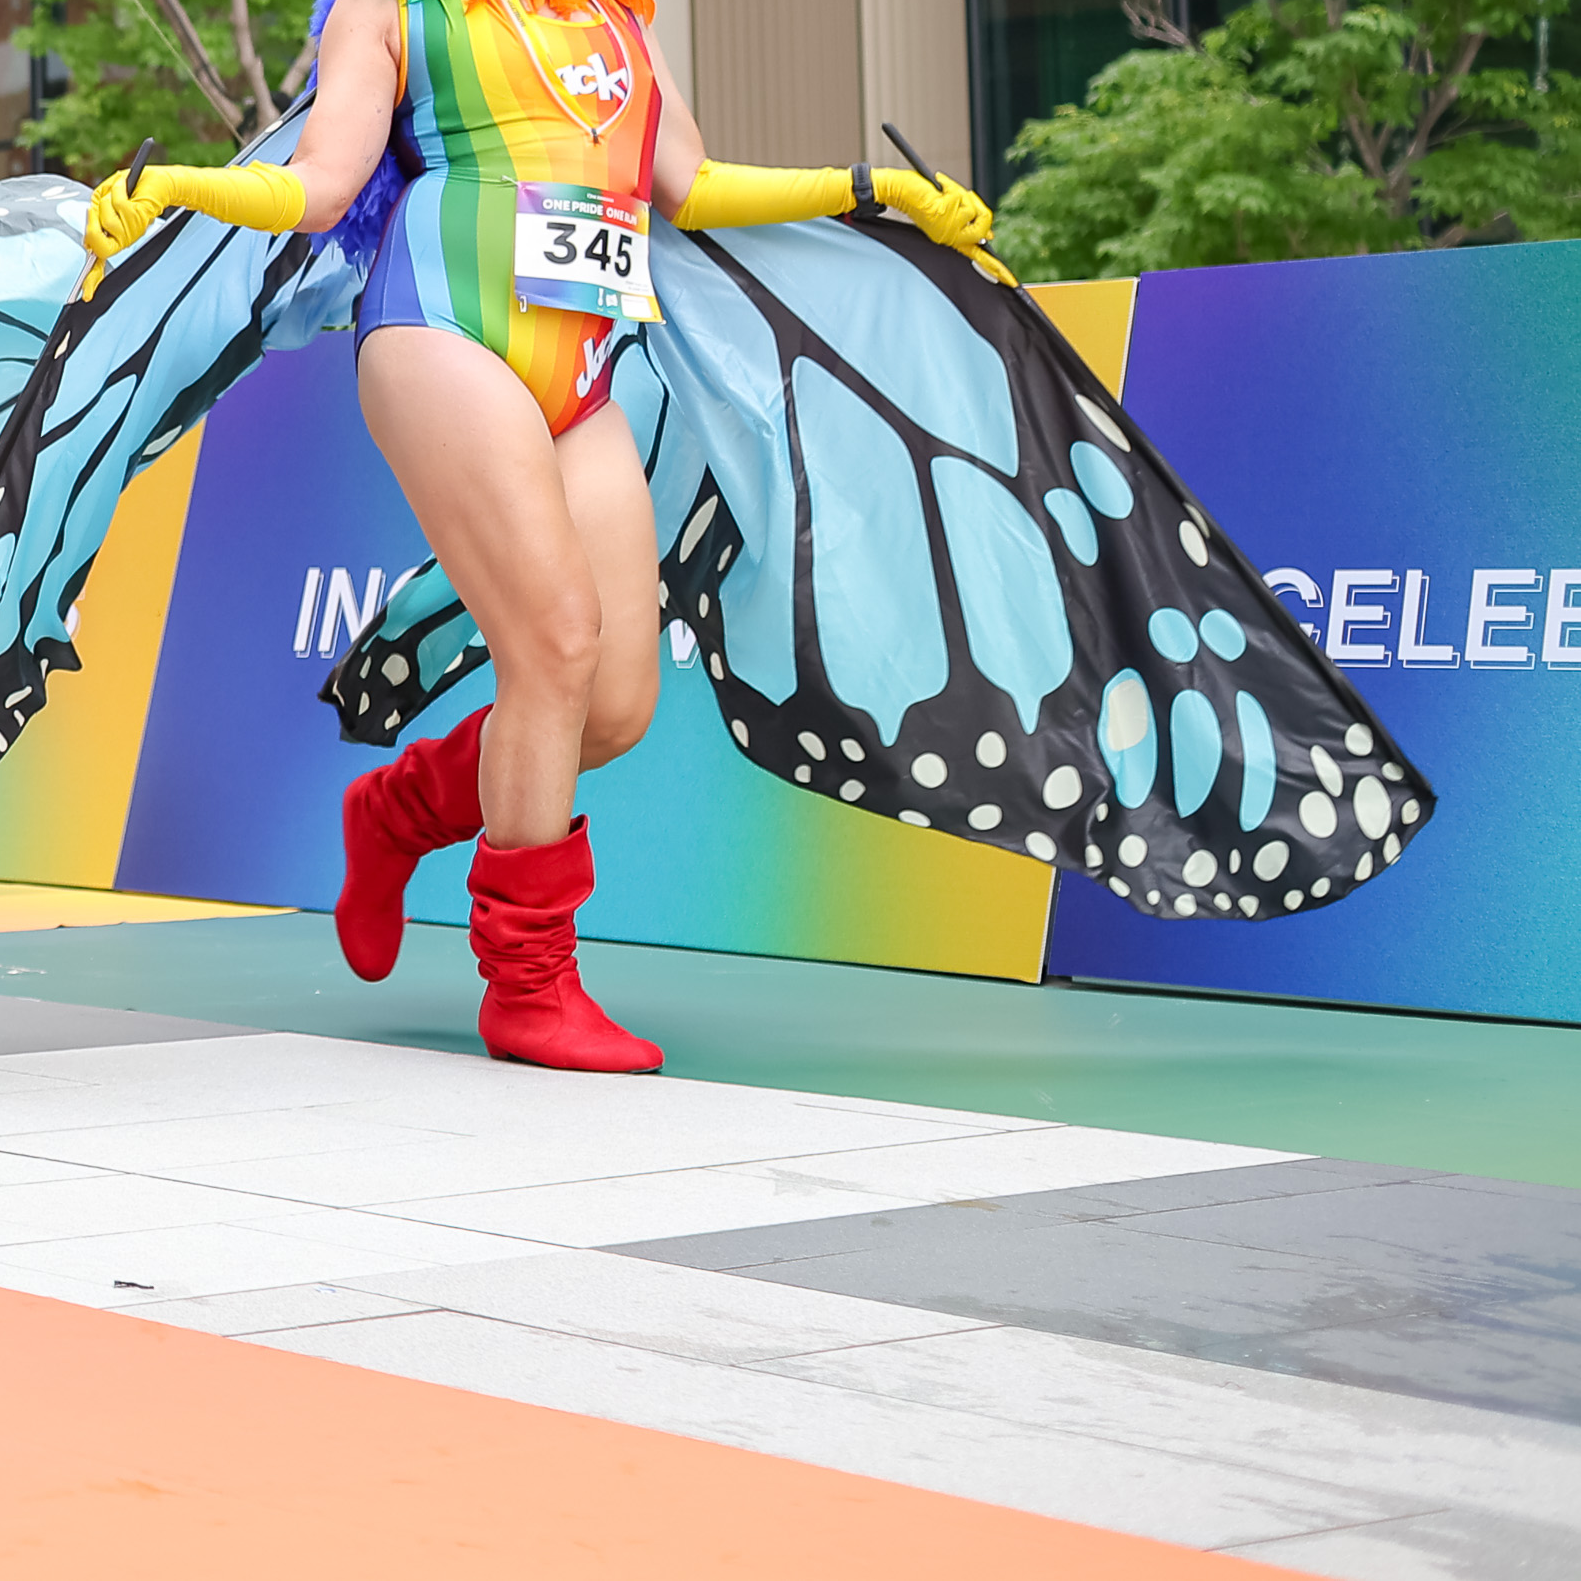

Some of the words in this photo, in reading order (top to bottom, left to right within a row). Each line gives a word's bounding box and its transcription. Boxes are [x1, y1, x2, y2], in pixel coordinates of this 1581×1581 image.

[542, 198, 571, 211] ONE
[571, 200, 604, 216] PRIDE
[605, 206, 625, 221] ONE
[543, 222, 632, 277] 345
[293, 567, 420, 660] IN
